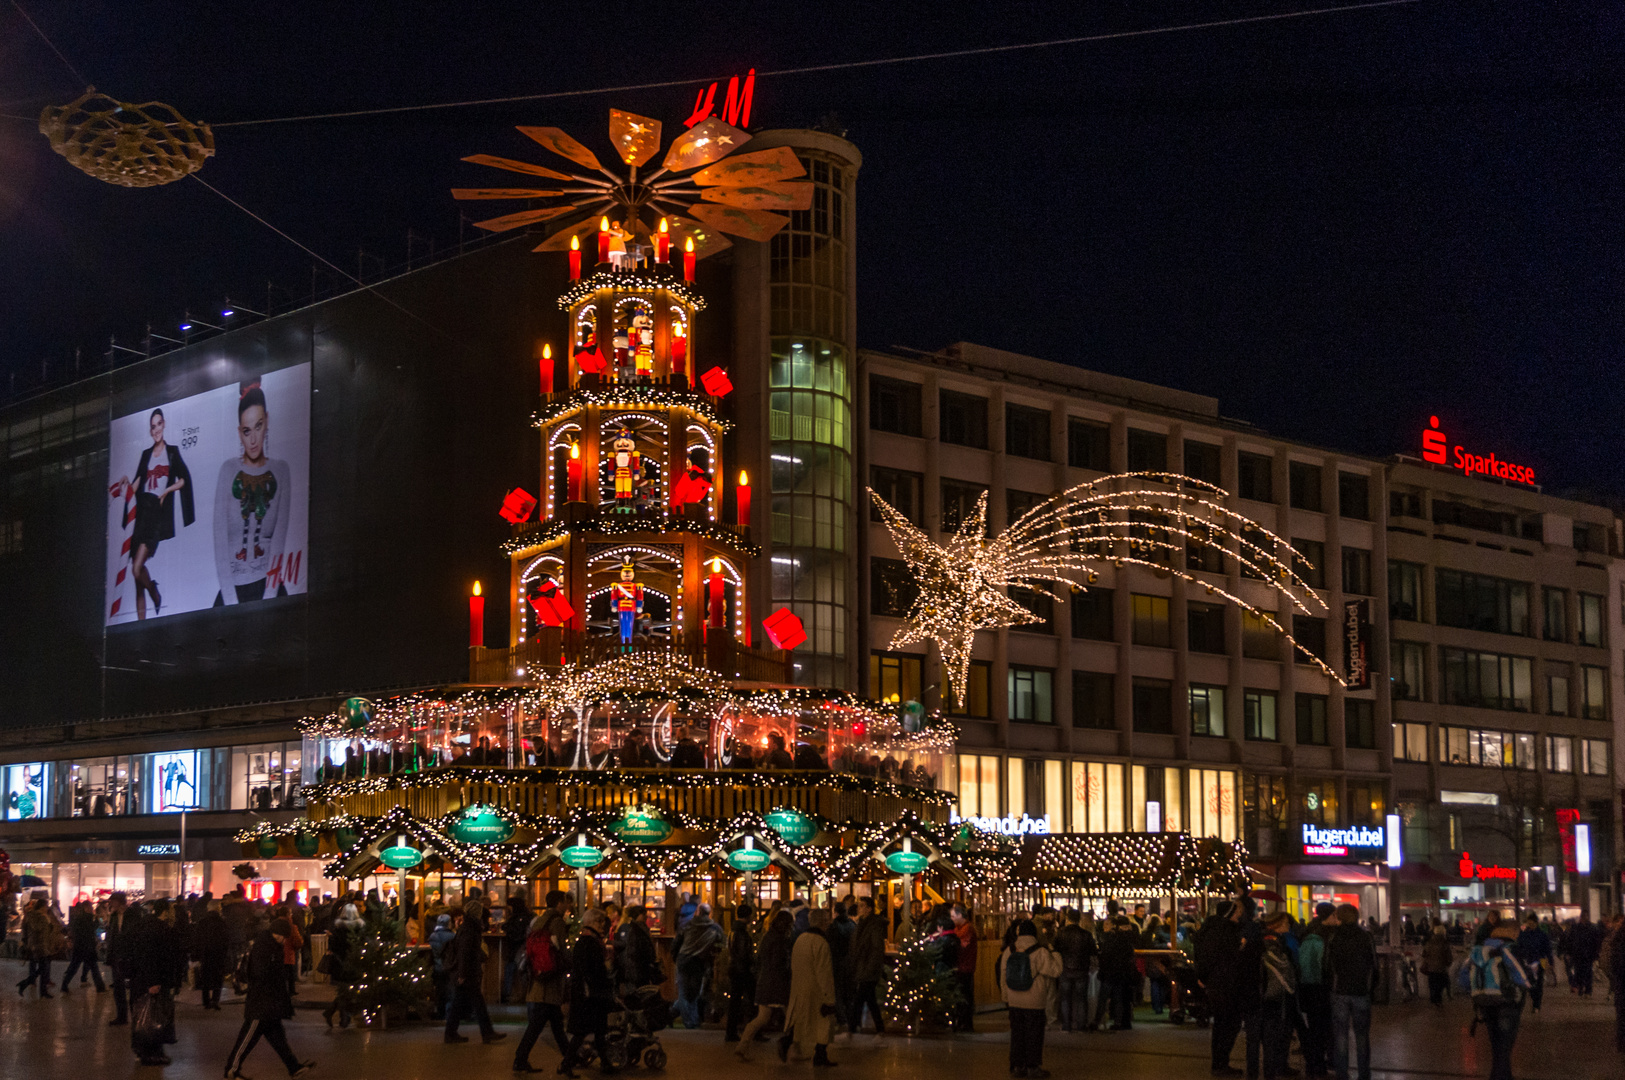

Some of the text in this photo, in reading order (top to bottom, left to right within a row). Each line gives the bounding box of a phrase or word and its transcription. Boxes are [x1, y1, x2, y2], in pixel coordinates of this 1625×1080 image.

[683, 68, 755, 129] HM
[1453, 445, 1536, 486] Sparkasse
[266, 550, 302, 589] H&M
[1346, 604, 1361, 687] Hugendubel
[1303, 823, 1384, 849] Hugendubel
